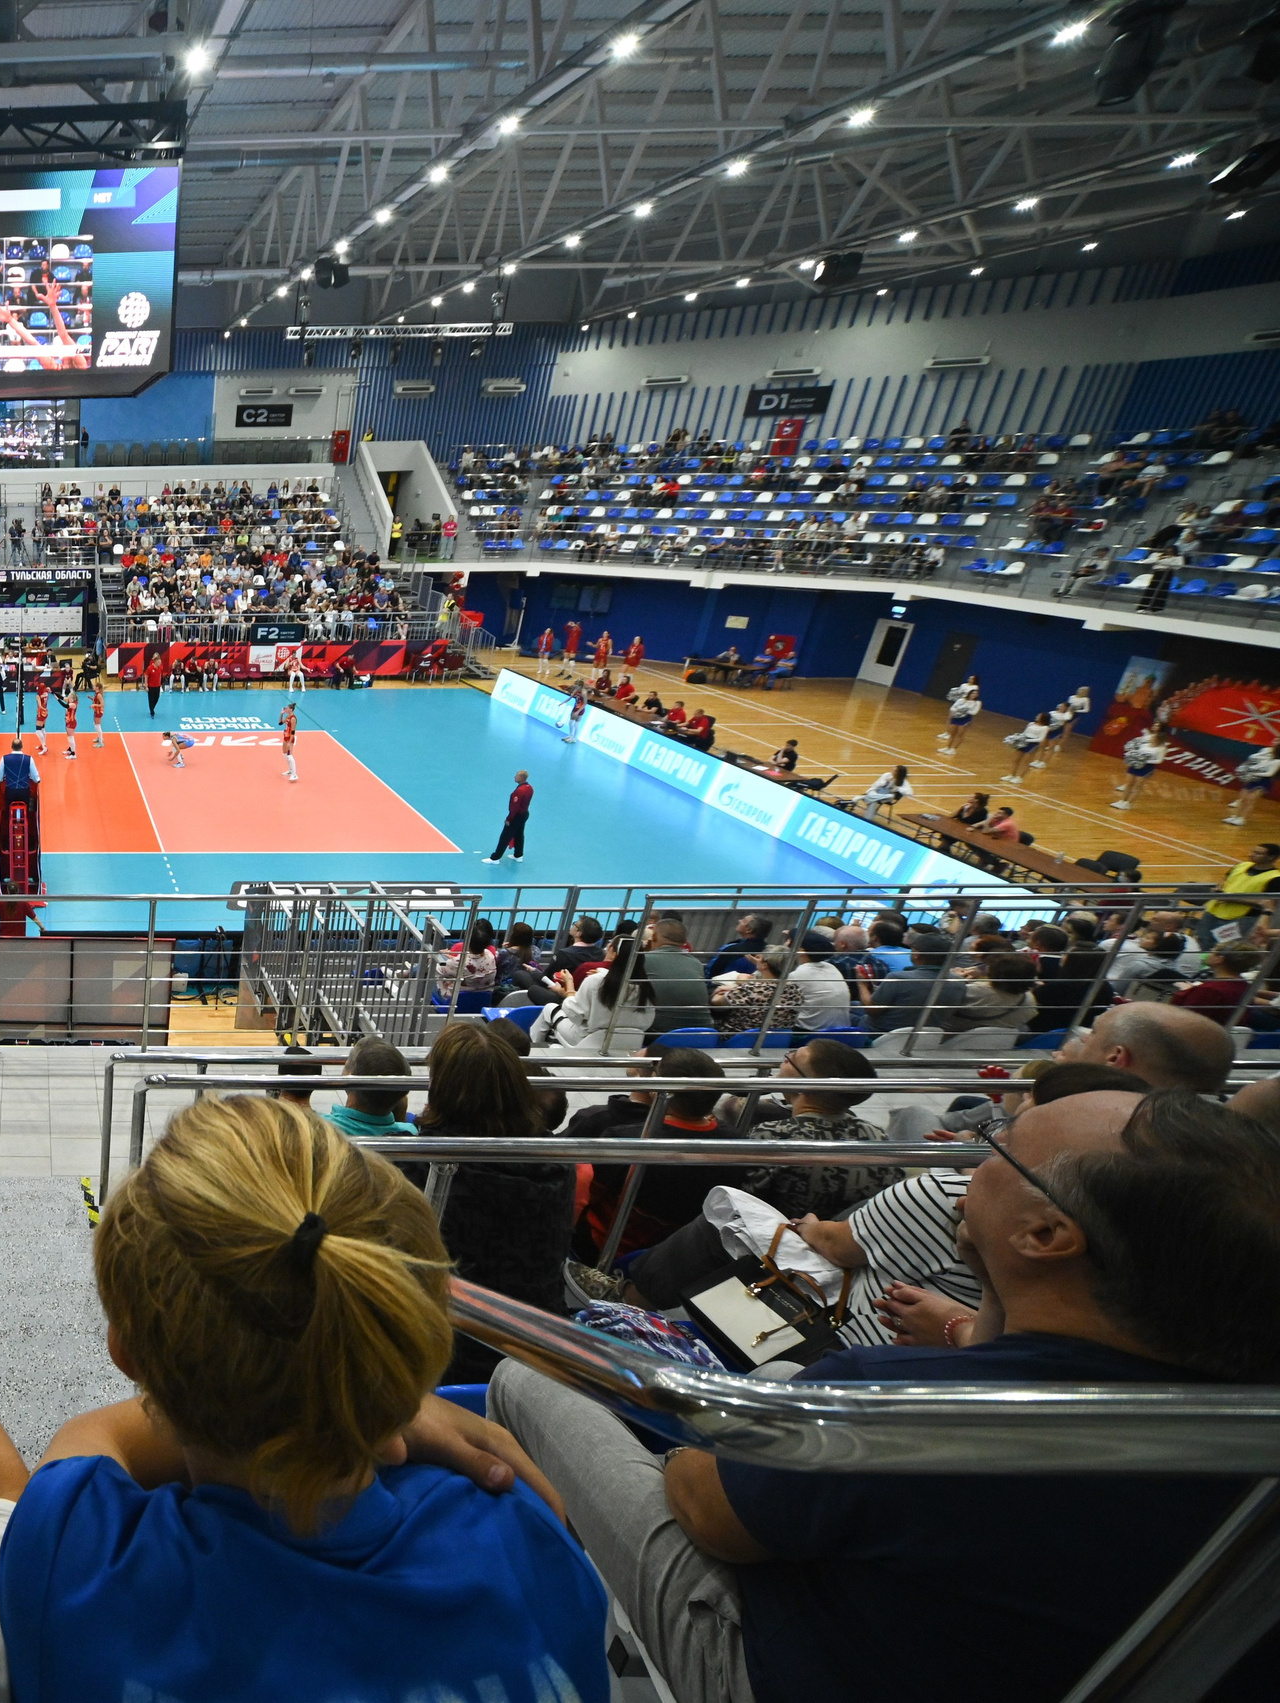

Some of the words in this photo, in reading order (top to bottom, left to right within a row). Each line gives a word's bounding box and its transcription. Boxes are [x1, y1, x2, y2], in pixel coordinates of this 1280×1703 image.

[243, 409, 268, 422] C2
[759, 394, 789, 410] D1
[10, 571, 52, 580] ТУЛЬСКАЯ
[55, 570, 91, 580] ОБЛАСТЬ
[257, 627, 279, 639] F2
[535, 693, 573, 725] ГАЗПРО
[638, 740, 707, 787] ГАЗПРОМ
[1164, 745, 1237, 785] УЛИЦА
[731, 798, 774, 826] ГАЗПРОМ
[796, 811, 905, 878] ГАЗПРОМ
